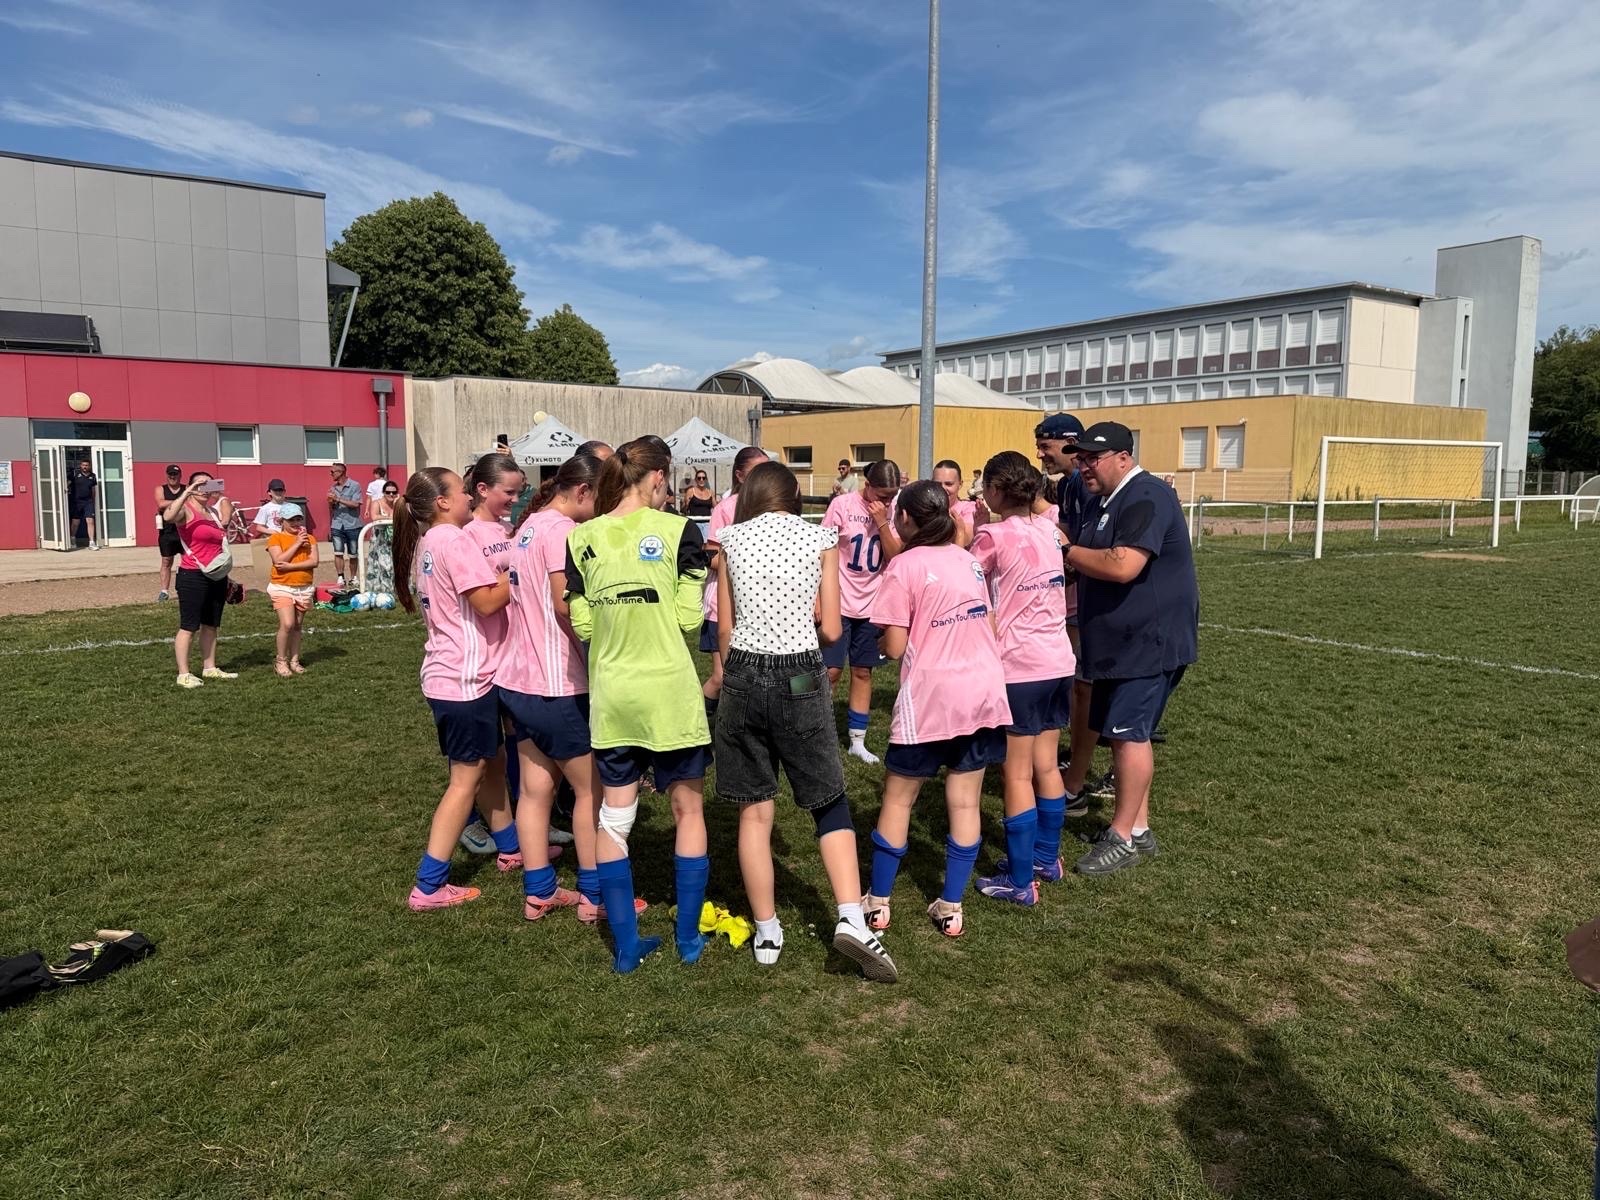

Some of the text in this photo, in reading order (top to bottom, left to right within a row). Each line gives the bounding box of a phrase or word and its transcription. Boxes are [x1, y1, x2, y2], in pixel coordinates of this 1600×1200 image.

[701, 445, 737, 453] XLMOTO
[847, 533, 884, 573] 10
[1016, 583, 1040, 592] Danh
[603, 597, 643, 606] Tourisme
[931, 617, 956, 628] Danh
